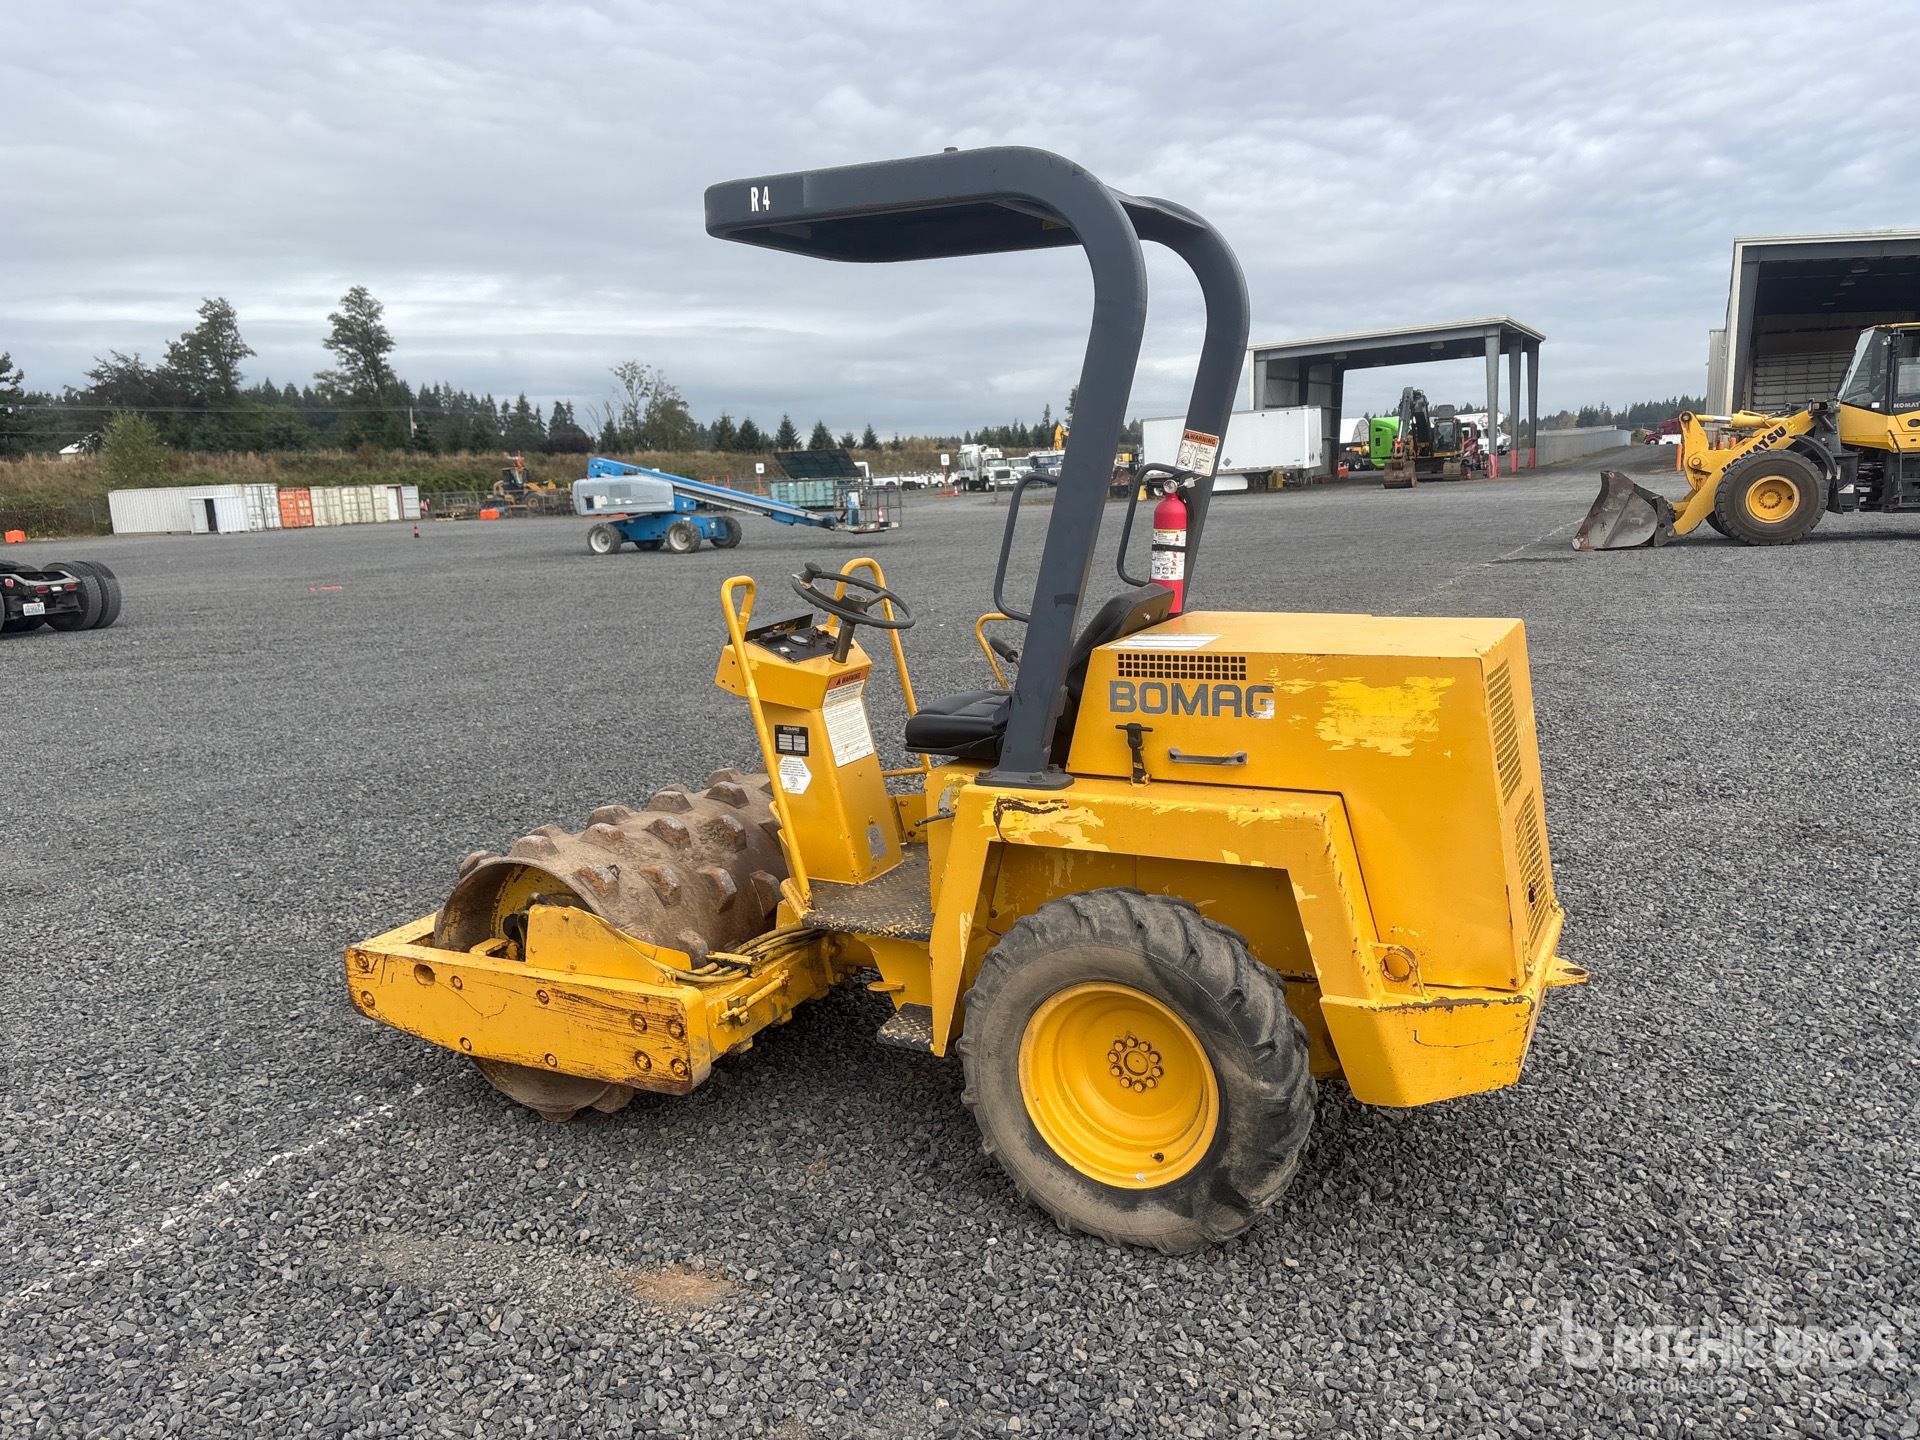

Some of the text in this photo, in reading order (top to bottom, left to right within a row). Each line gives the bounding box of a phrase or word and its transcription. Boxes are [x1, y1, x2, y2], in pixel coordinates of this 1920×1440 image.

[1190, 434, 1216, 445] WARNING
[842, 673, 861, 683] WARNING
[1109, 680, 1275, 719] BOMAG
